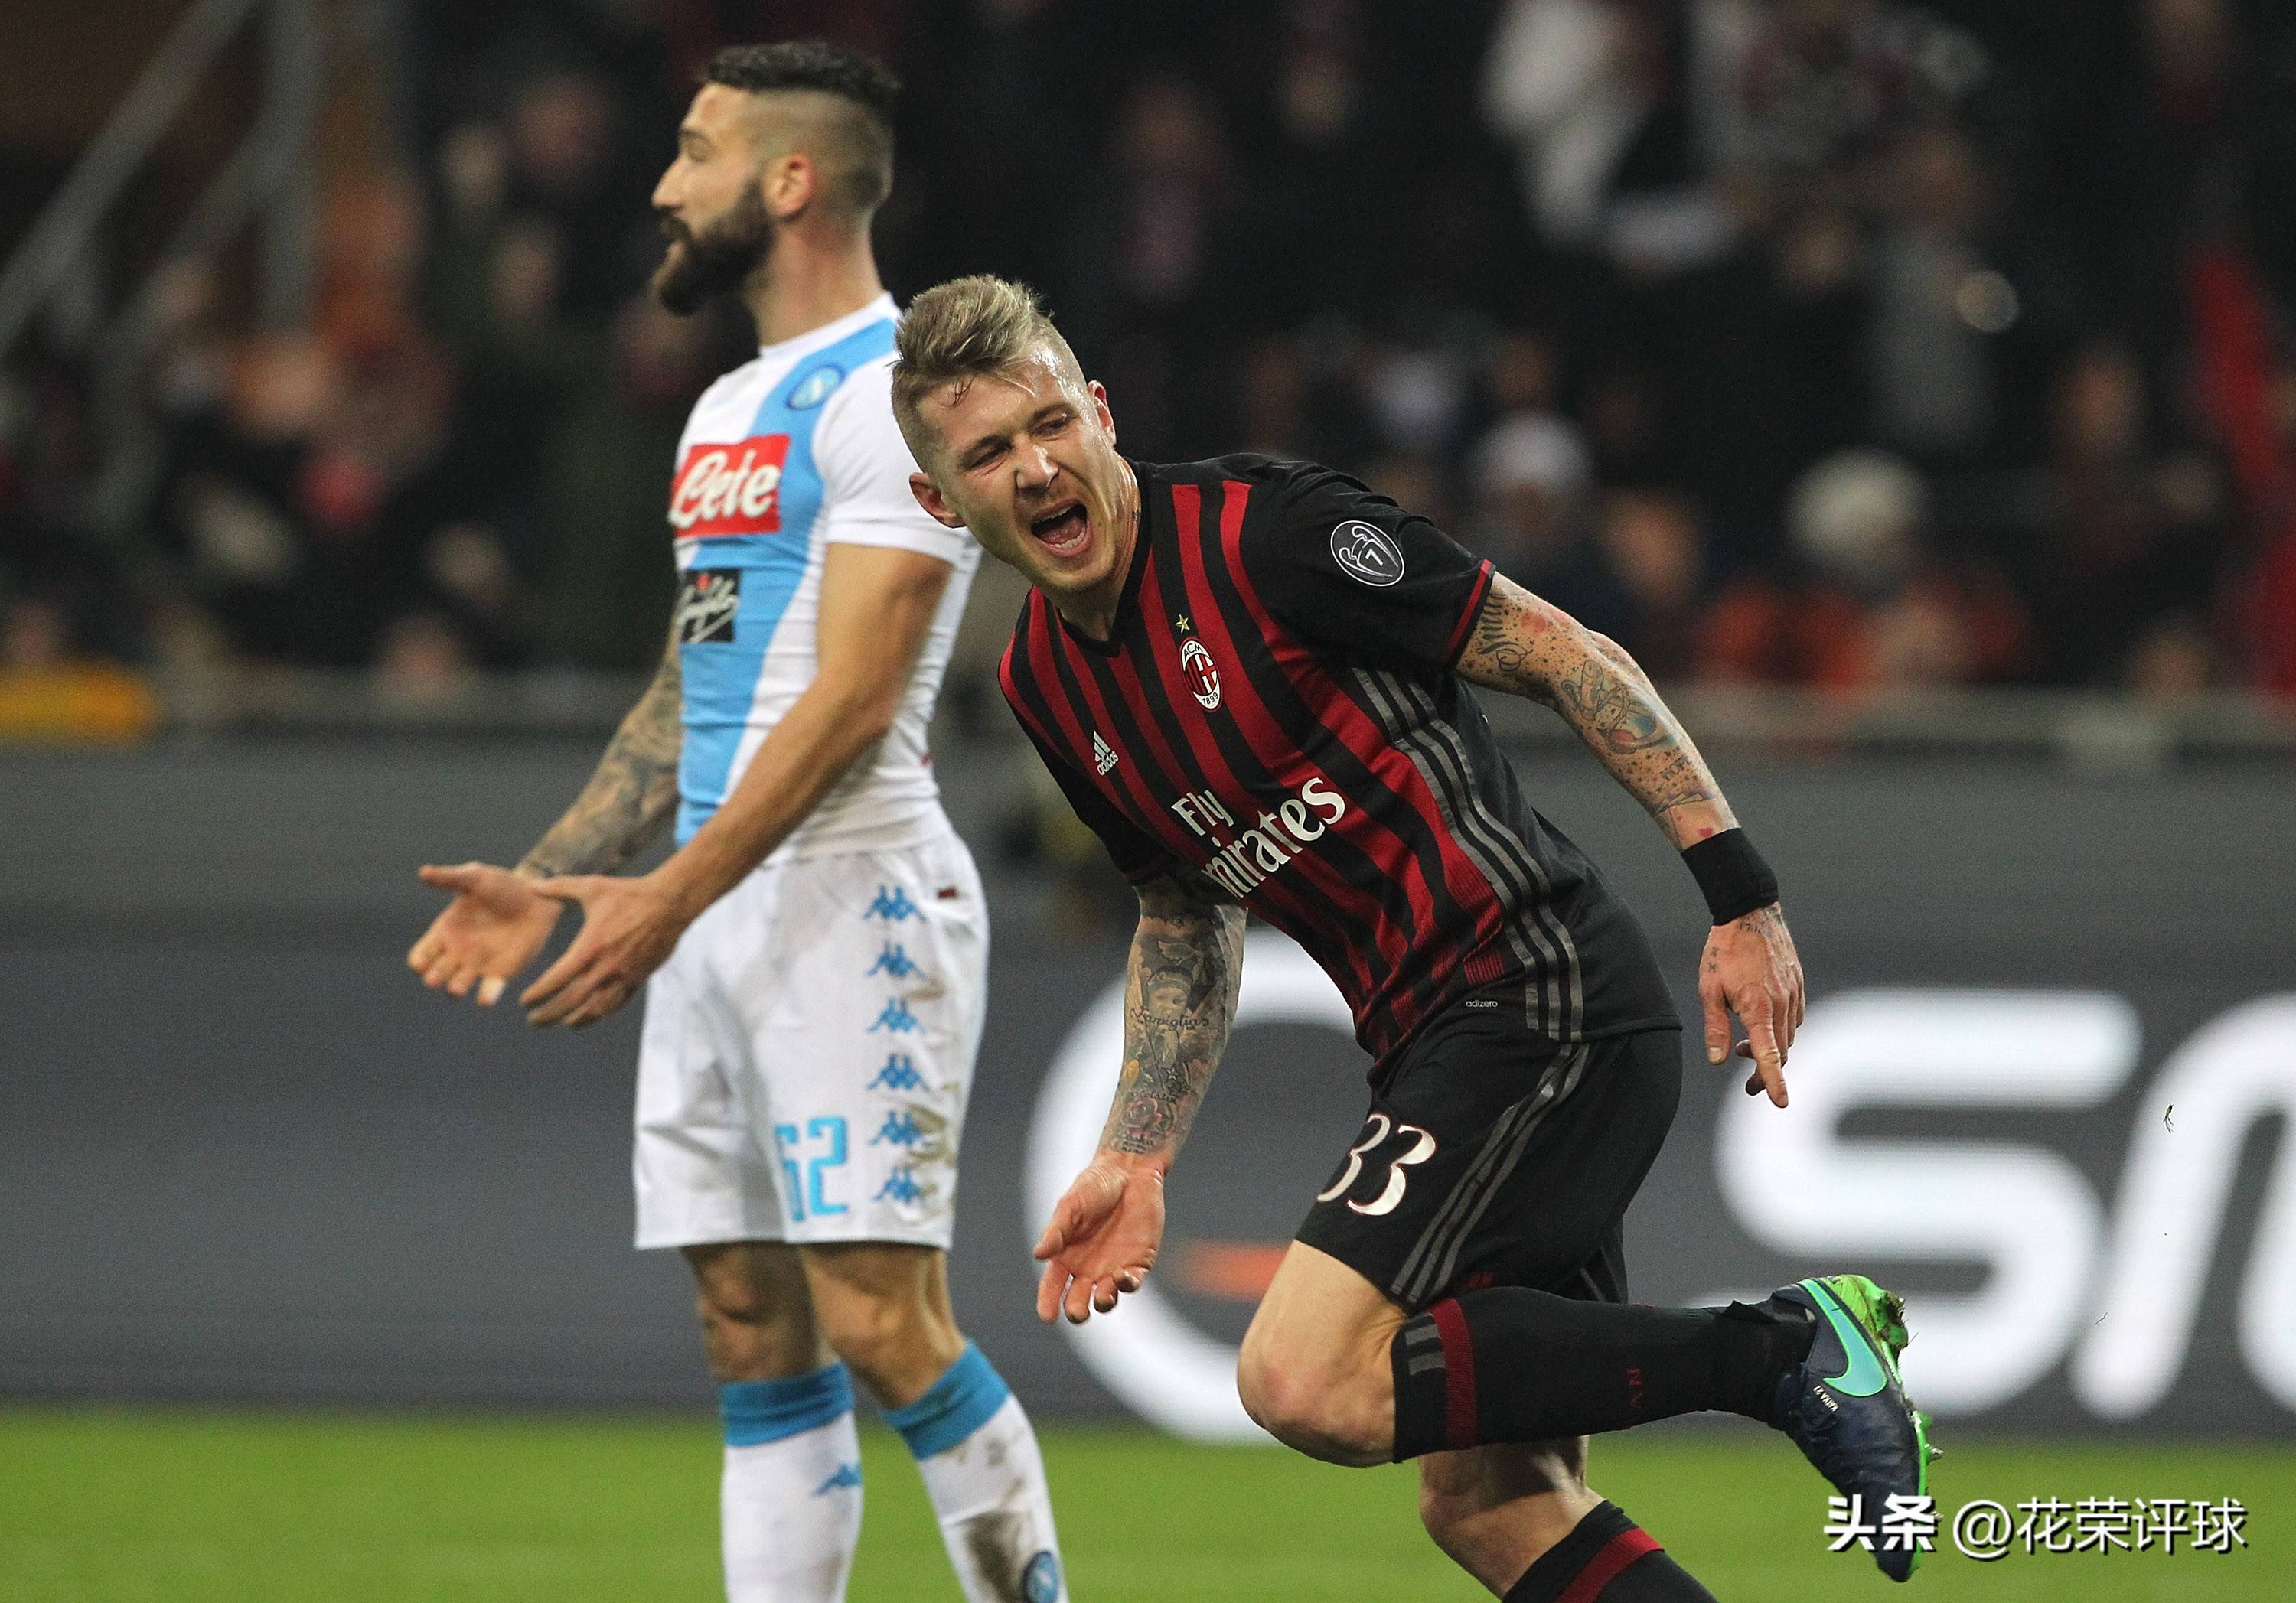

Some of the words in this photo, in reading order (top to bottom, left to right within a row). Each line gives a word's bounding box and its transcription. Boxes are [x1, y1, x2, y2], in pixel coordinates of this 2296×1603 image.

[1365, 548, 1384, 566] 7
[1184, 643, 1204, 662] ACM
[1202, 692, 1218, 705] 1899
[1097, 751, 1119, 776] adidas
[1172, 790, 1234, 836] Fly
[1200, 777, 1345, 900] mirates
[1466, 999, 1499, 1008] adizero
[1316, 1113, 1437, 1216] 33
